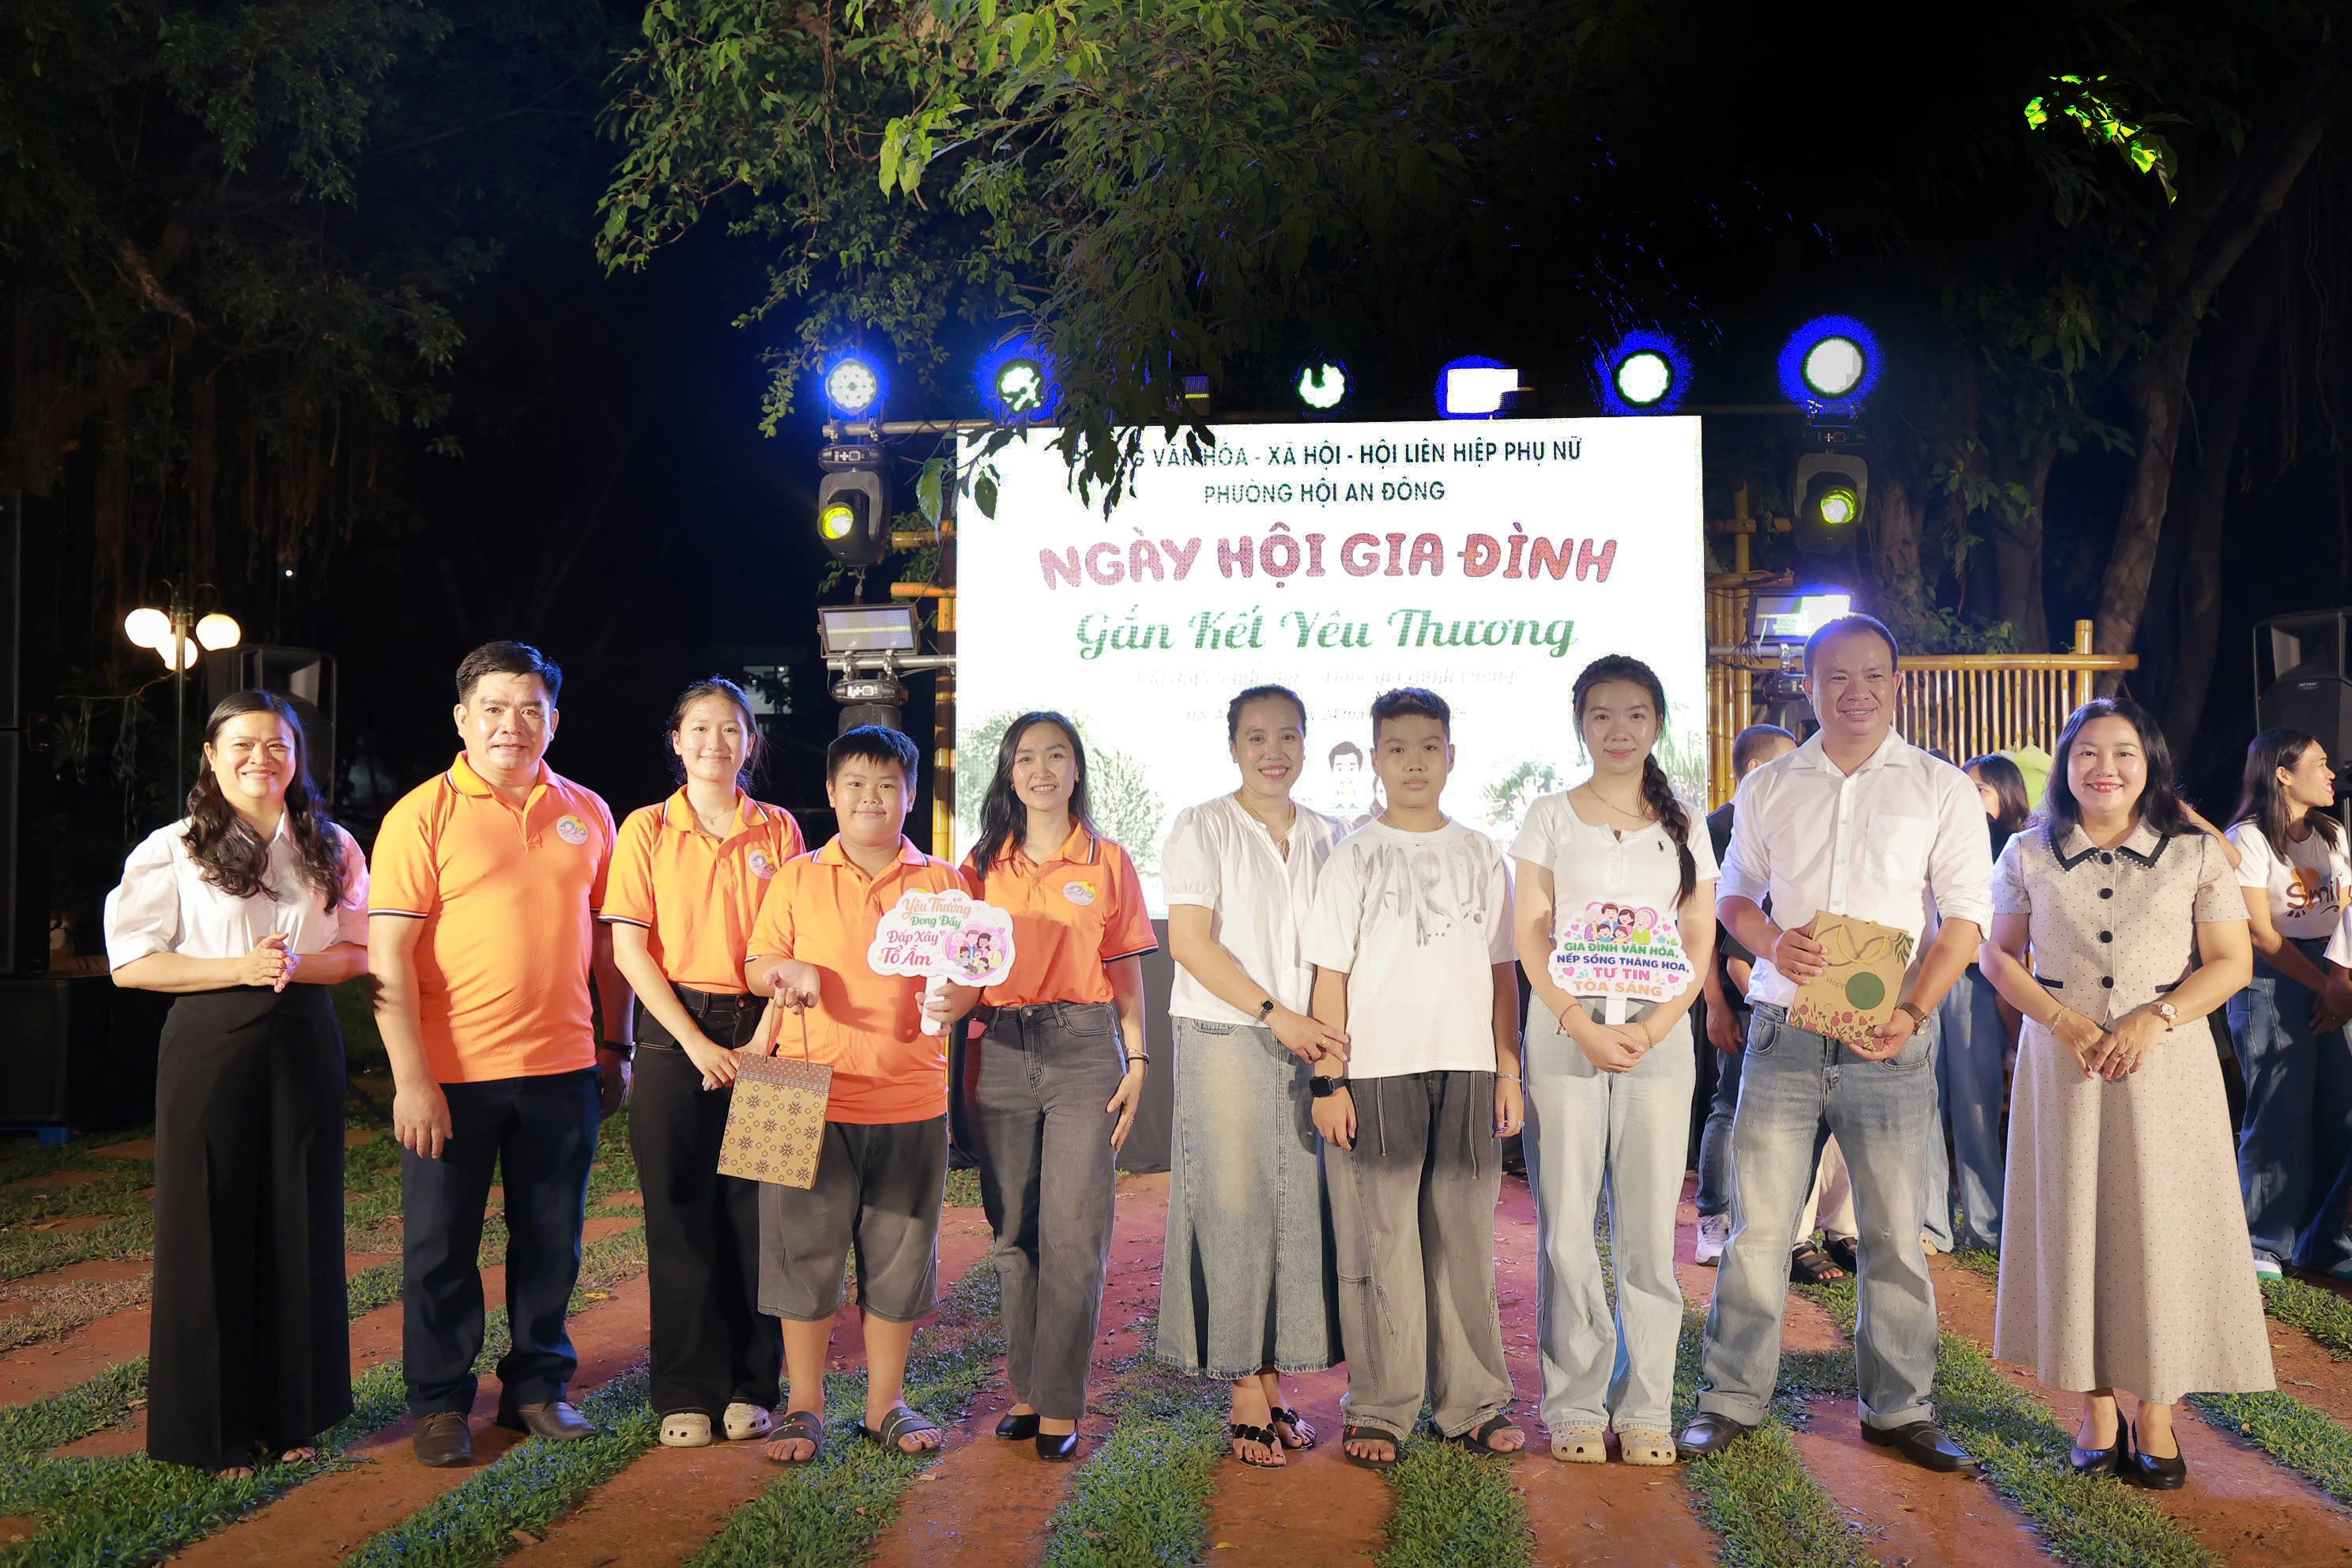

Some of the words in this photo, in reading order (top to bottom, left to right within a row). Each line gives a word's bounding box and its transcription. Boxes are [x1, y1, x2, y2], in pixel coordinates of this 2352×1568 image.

[1153, 443, 1195, 466] VĂN
[1203, 443, 1248, 466] HÓA
[1304, 440, 1340, 470] HỘI
[1360, 439, 1396, 469] HỘI
[1405, 438, 1445, 463] LIÊN
[1454, 436, 1497, 468] HIỆP
[1505, 441, 1545, 466] PHỤ
[1553, 435, 1582, 460] NỮ
[1301, 477, 1337, 508] HỘI
[1345, 482, 1374, 502] AN
[1381, 476, 1446, 501] ĐÔNG
[1039, 526, 1202, 590] NGÀY
[1217, 522, 1327, 589] HỘI
[1340, 533, 1443, 577] GIA
[1457, 522, 1617, 583] ĐÌNH
[1076, 603, 1176, 660] Gắn
[1188, 605, 1266, 650] Kết
[1279, 609, 1373, 649] Yêu
[1387, 609, 1579, 658] Thương
[2286, 877, 2340, 910] Smil
[902, 897, 927, 919] Yêu
[928, 898, 971, 918] Thương
[910, 916, 937, 928] Đong
[938, 915, 961, 930] Đầy
[886, 929, 913, 946] Đắp
[914, 931, 939, 946] Xây
[880, 944, 903, 963] Tổ
[900, 944, 933, 966] Ấm
[1564, 942, 1585, 952] GIA
[1588, 940, 1618, 952] ĐÌNH
[1621, 944, 1646, 955] VĂN
[1649, 944, 1679, 959] HÓA,
[1556, 952, 1580, 963] NẾP
[1583, 953, 1616, 965] SỐNG
[1619, 956, 1659, 968] THĂNG
[1661, 961, 1690, 974] HOA,
[1593, 967, 1617, 981] TỰ
[1622, 968, 1650, 981] TIN
[1615, 981, 1662, 997] SÁNG
[1826, 976, 1847, 990] Happ
